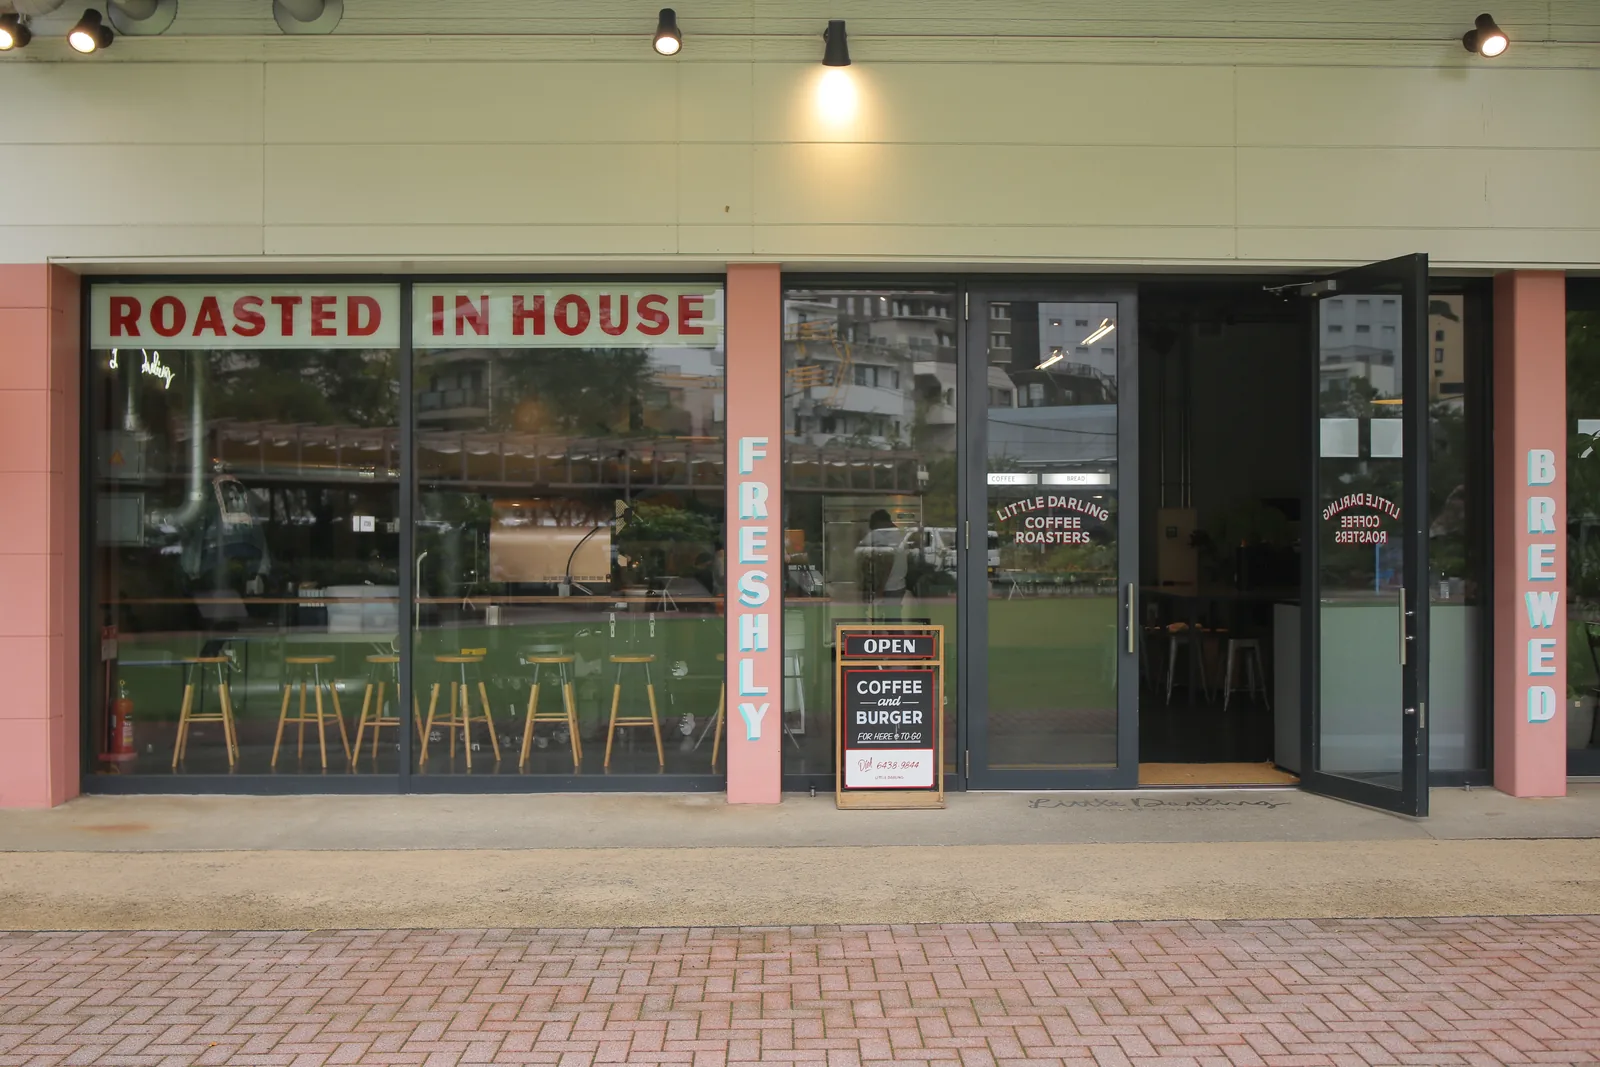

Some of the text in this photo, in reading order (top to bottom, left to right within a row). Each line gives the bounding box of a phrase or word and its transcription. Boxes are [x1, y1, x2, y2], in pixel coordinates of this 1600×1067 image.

[109, 294, 704, 337] ROASTED IN HOUSE
[991, 475, 1016, 483] COFFEE
[996, 496, 1109, 522] LITTLE DARLING
[1024, 517, 1082, 530] COFFEE
[1015, 531, 1091, 544] ROASTERS
[738, 437, 770, 741] FRESHLY
[1524, 449, 1559, 723] BREWED
[863, 639, 916, 654] OPEN
[856, 680, 923, 695] COFFEE
[877, 696, 902, 707] and
[856, 710, 923, 725] BURGER
[857, 732, 873, 741] FOR
[873, 732, 893, 741] HERE
[857, 757, 873, 772] Dial
